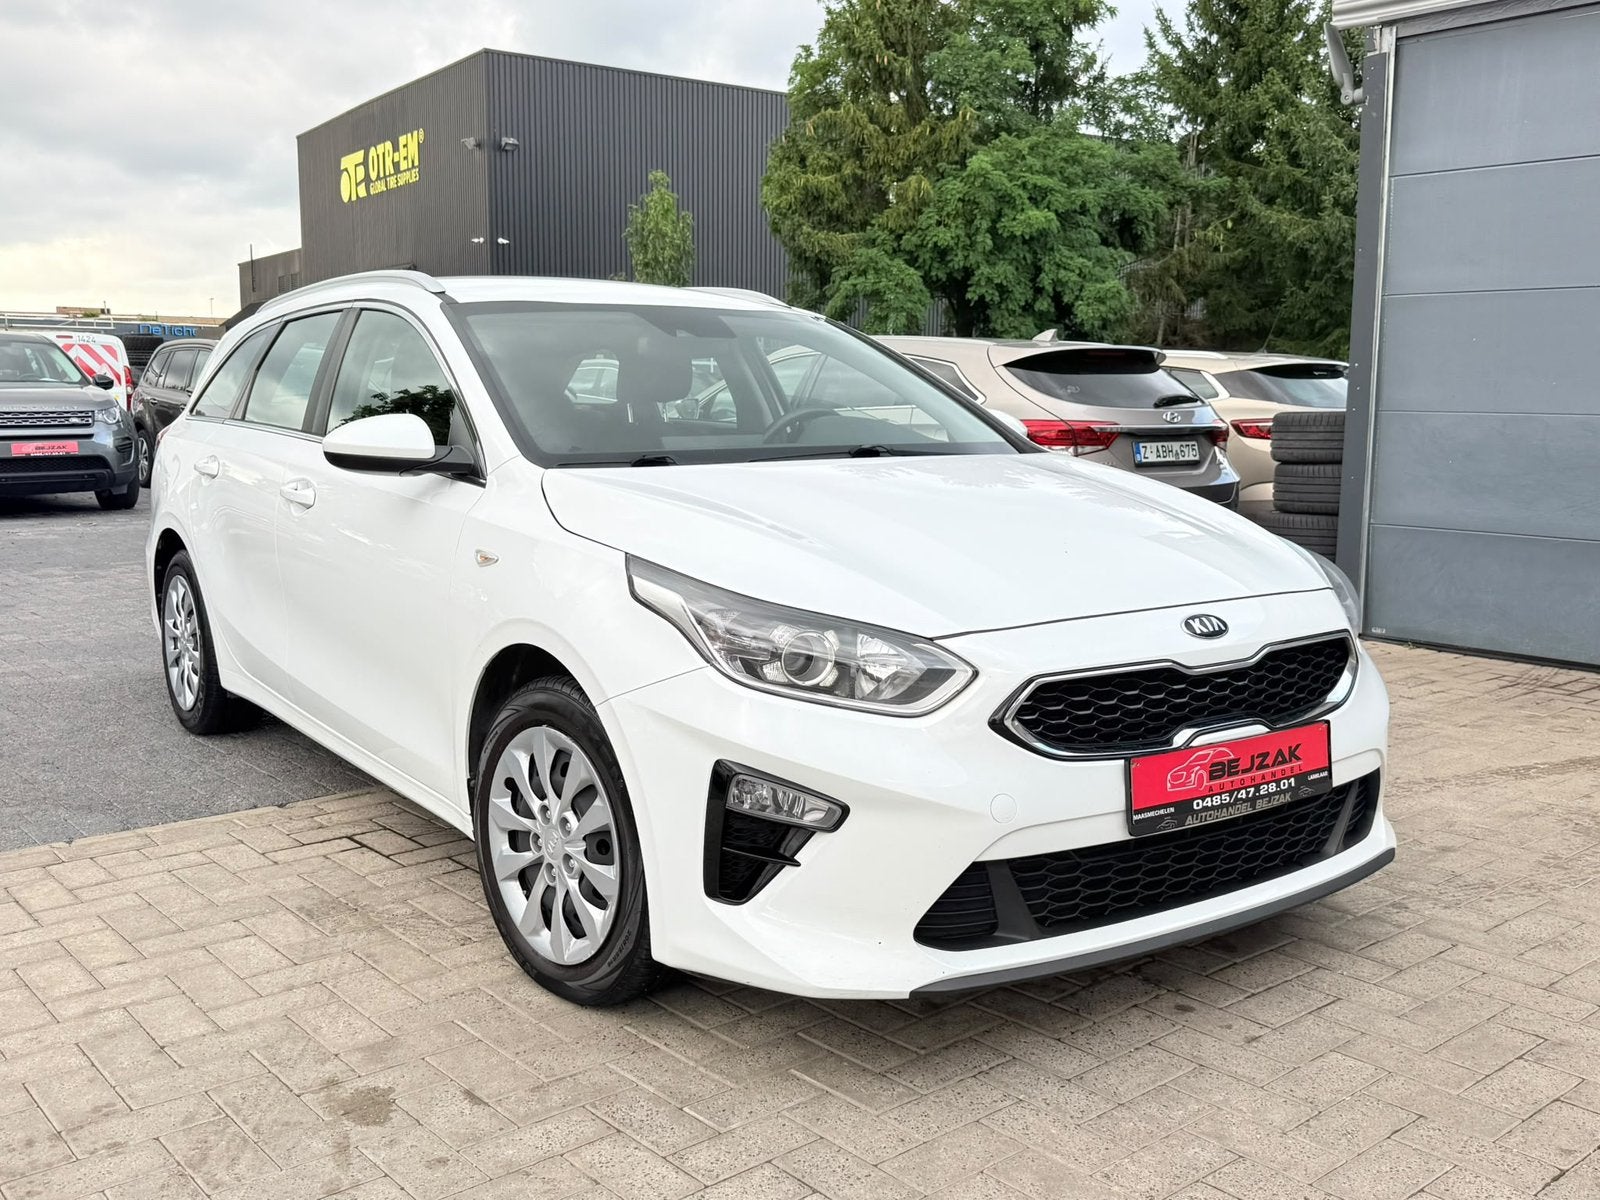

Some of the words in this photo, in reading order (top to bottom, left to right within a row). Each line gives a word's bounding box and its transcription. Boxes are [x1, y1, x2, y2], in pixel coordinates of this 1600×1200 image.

[1187, 616, 1226, 634] KIA
[1209, 743, 1302, 780] BEJZAK
[1193, 777, 1295, 810] 0485/47.28.01
[1208, 764, 1303, 793] AUTOHANDEL
[1132, 806, 1175, 821] MAASMECHELEN
[1184, 801, 1253, 826] AUTOHANDEL
[1255, 791, 1292, 810] BEJZAK
